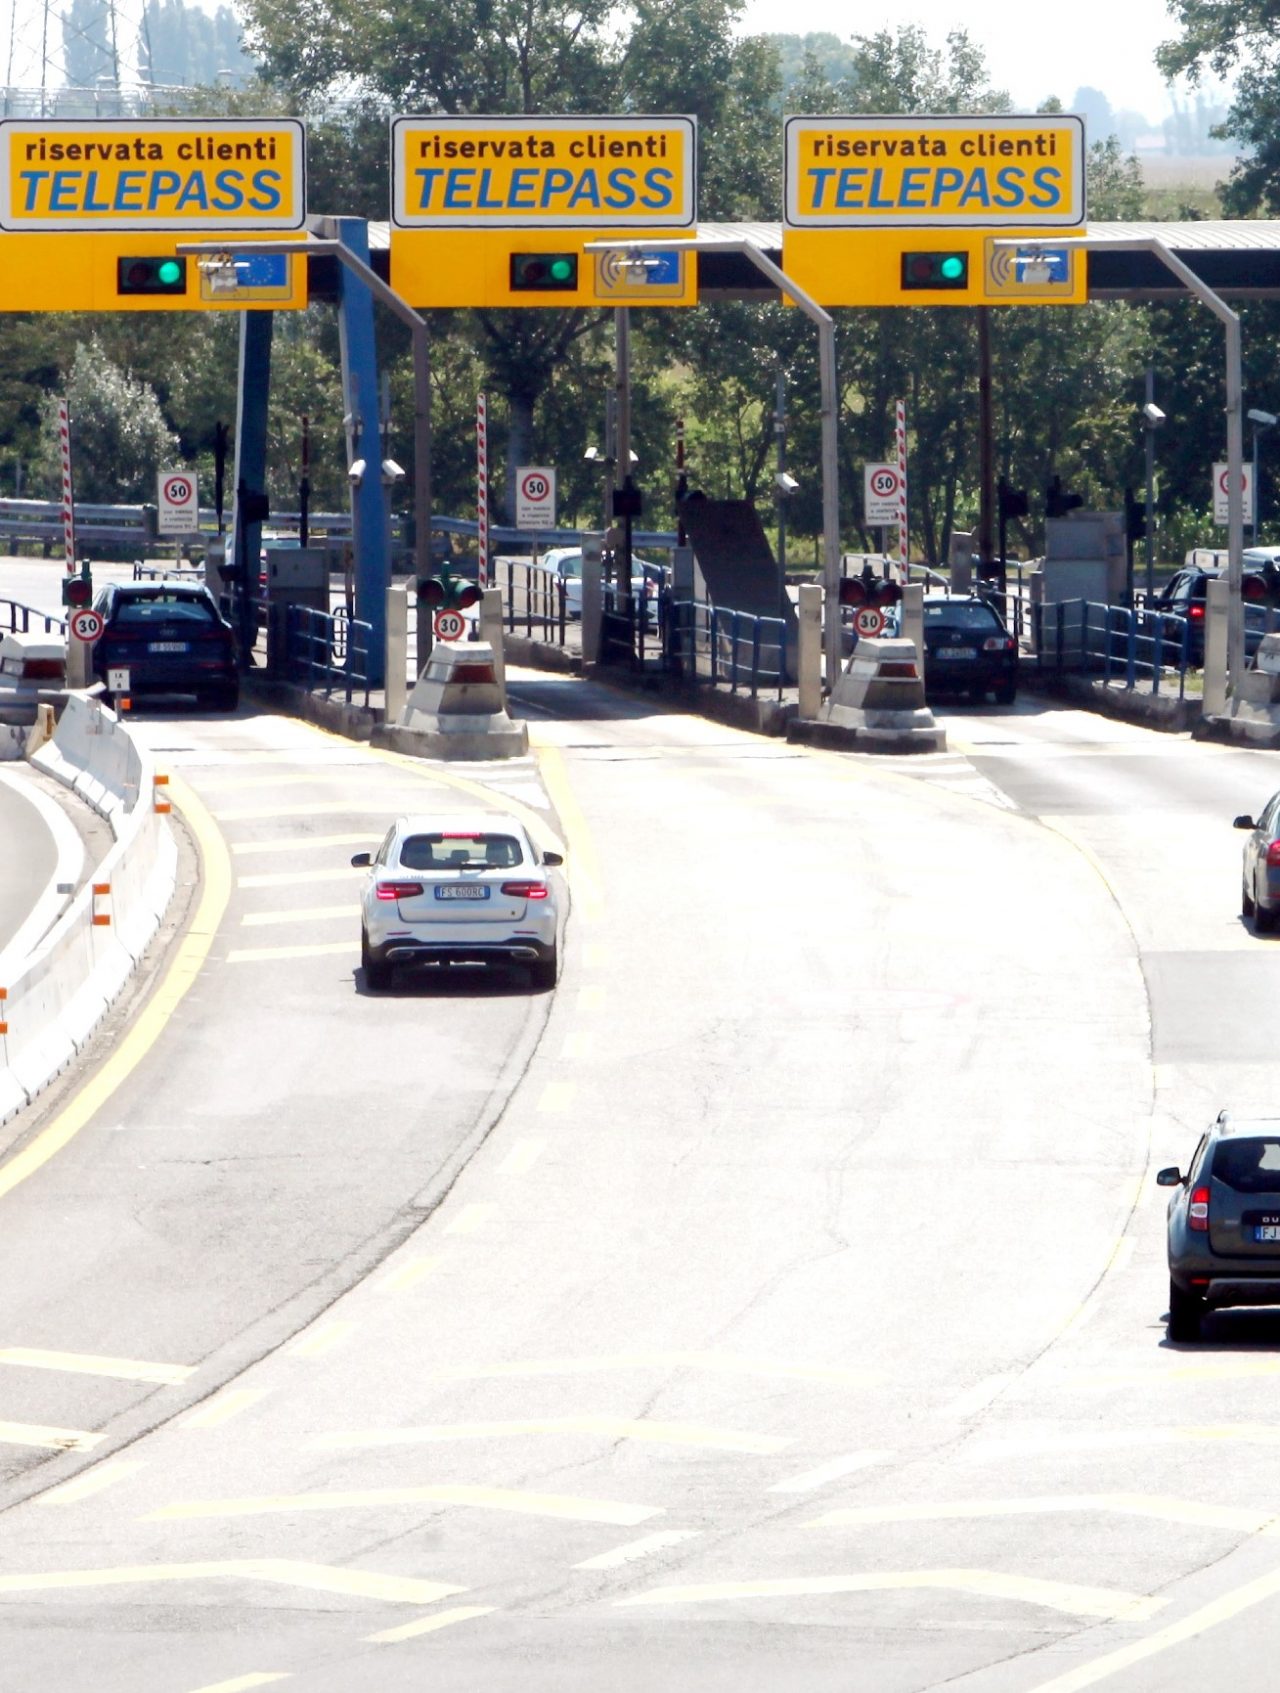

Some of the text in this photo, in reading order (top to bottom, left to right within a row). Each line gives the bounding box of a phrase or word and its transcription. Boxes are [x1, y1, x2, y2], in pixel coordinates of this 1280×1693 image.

[26, 136, 276, 161] riservata clienti
[420, 135, 667, 158] riservata clienti
[813, 133, 1056, 157] riservata clienti
[19, 169, 282, 212] TELEPASS
[414, 167, 674, 209] TELEPASS
[806, 166, 1062, 209] TELEPASS
[529, 480, 544, 494] 50
[877, 476, 893, 490] 50
[170, 484, 187, 498] 50
[79, 618, 98, 633] 30
[440, 618, 459, 633] 30
[860, 614, 878, 628] 30
[1262, 1227, 1277, 1240] FJ
